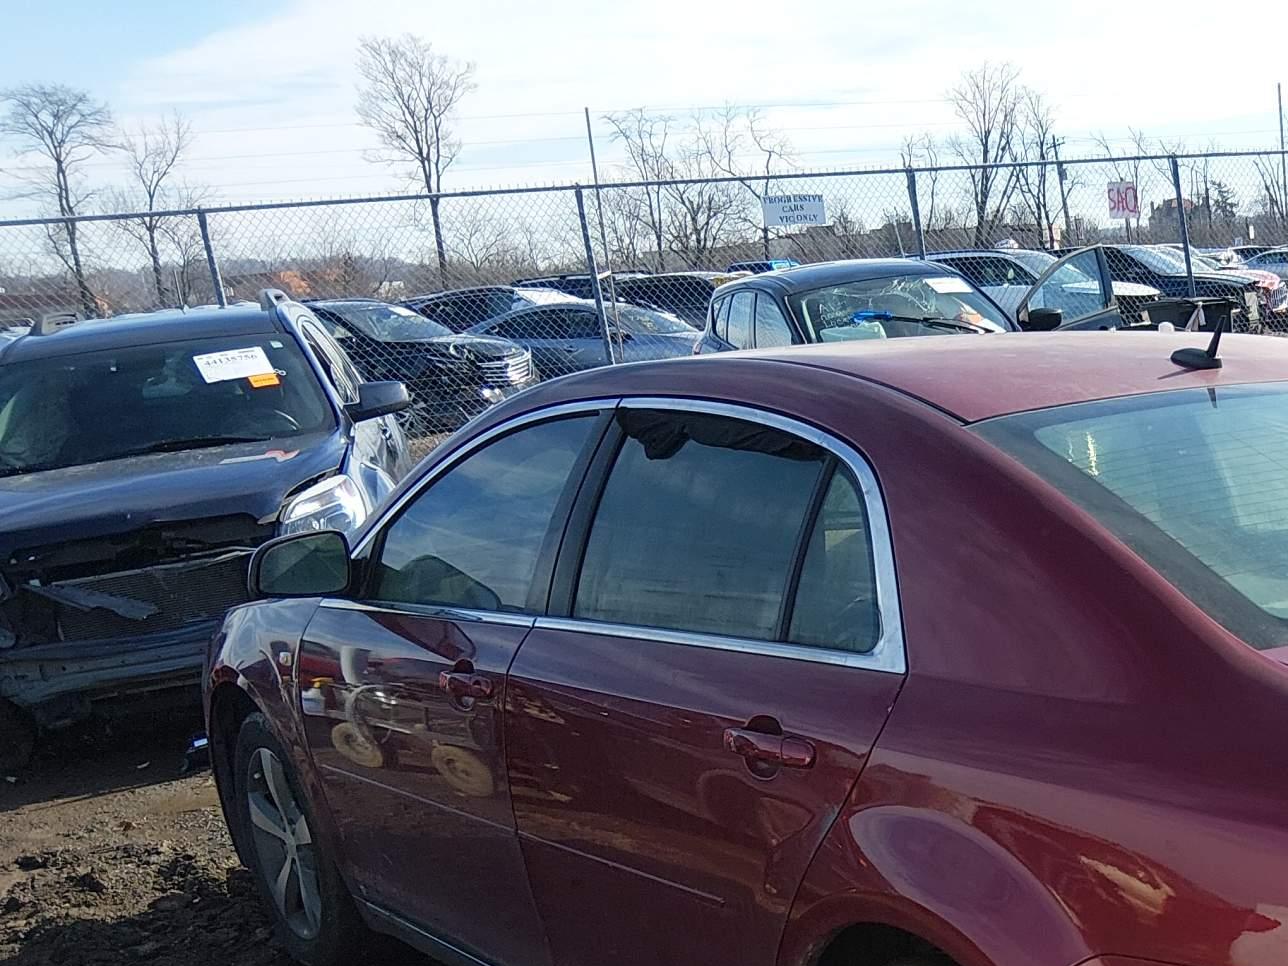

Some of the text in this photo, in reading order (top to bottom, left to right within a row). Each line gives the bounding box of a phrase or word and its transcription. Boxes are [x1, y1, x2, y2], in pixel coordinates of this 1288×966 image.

[763, 194, 823, 204] PROGRESSIVE
[782, 204, 805, 213] CARS
[779, 214, 818, 223] VIC ONLY
